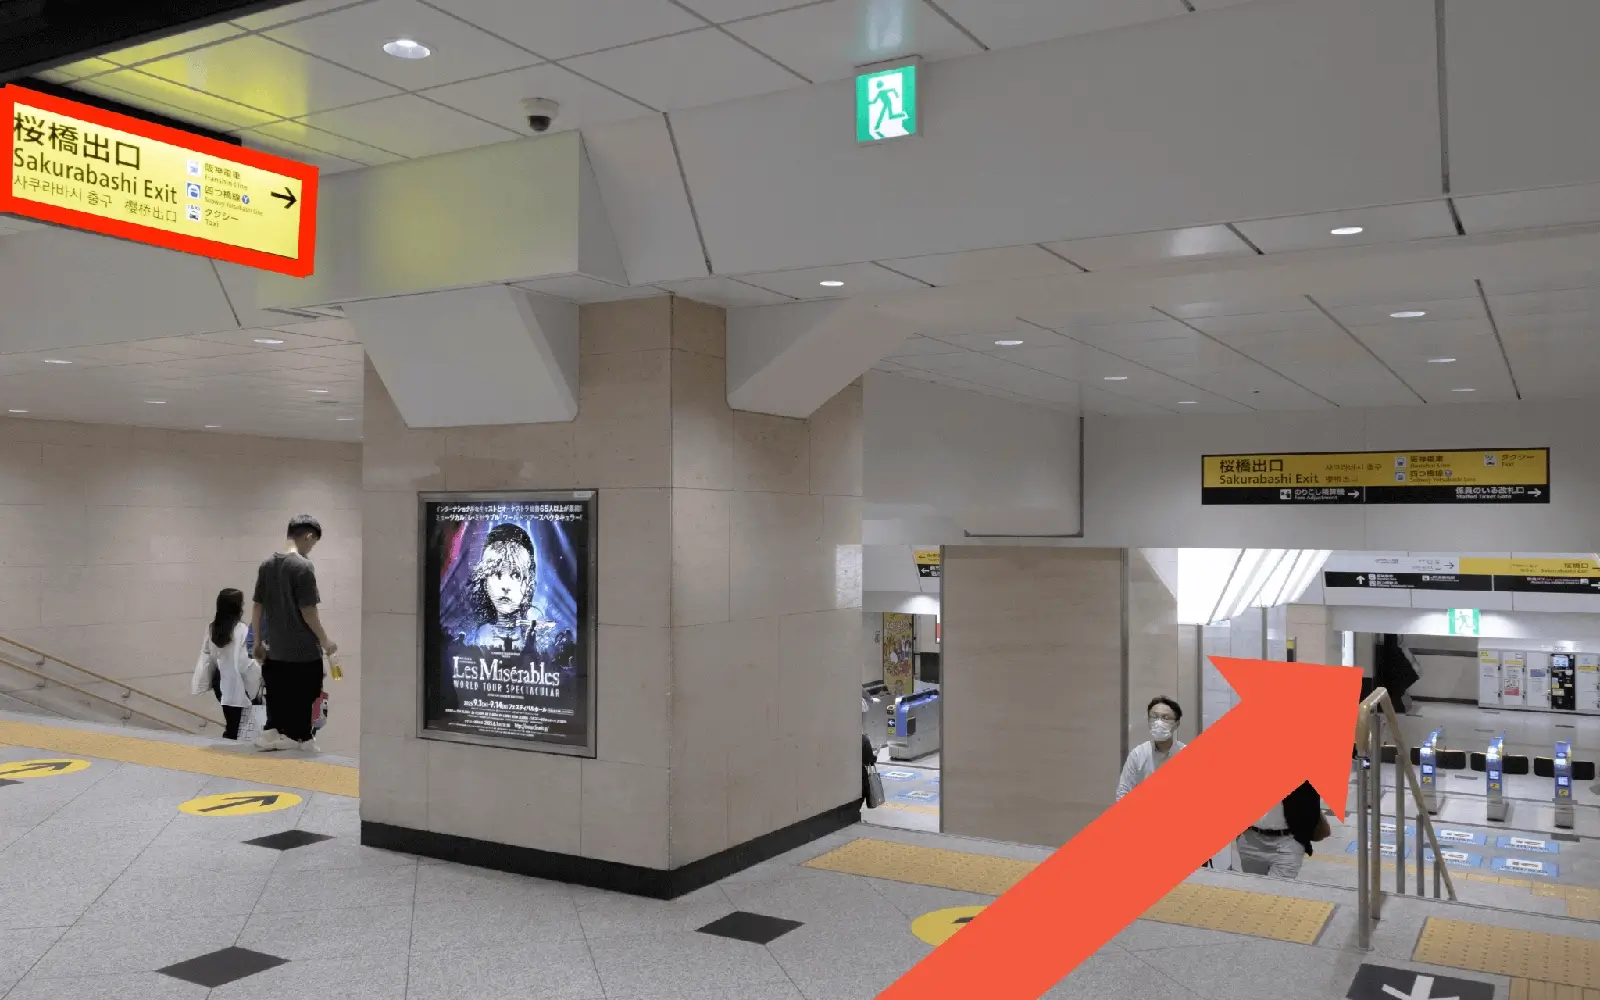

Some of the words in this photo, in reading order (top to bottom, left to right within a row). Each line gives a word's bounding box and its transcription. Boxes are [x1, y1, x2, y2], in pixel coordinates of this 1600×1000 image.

[14, 112, 141, 170] 桜橋出口
[14, 148, 137, 195] Sakurabashi
[144, 180, 178, 204] Exit
[14, 175, 82, 202] 사쿠라바시
[87, 191, 112, 208] 출구
[205, 186, 240, 202] 四つ橋線
[205, 208, 239, 220] タクシー
[205, 219, 219, 227] Taxi
[1219, 459, 1284, 473] 桜橋出口
[1219, 474, 1292, 485] Sakurabashi
[1296, 473, 1319, 484] Exit
[452, 656, 478, 680] Les
[480, 659, 560, 686] Misérables
[453, 680, 479, 691] WORLD
[483, 682, 502, 692] TOUR
[506, 685, 560, 698] SPECTACULAR
